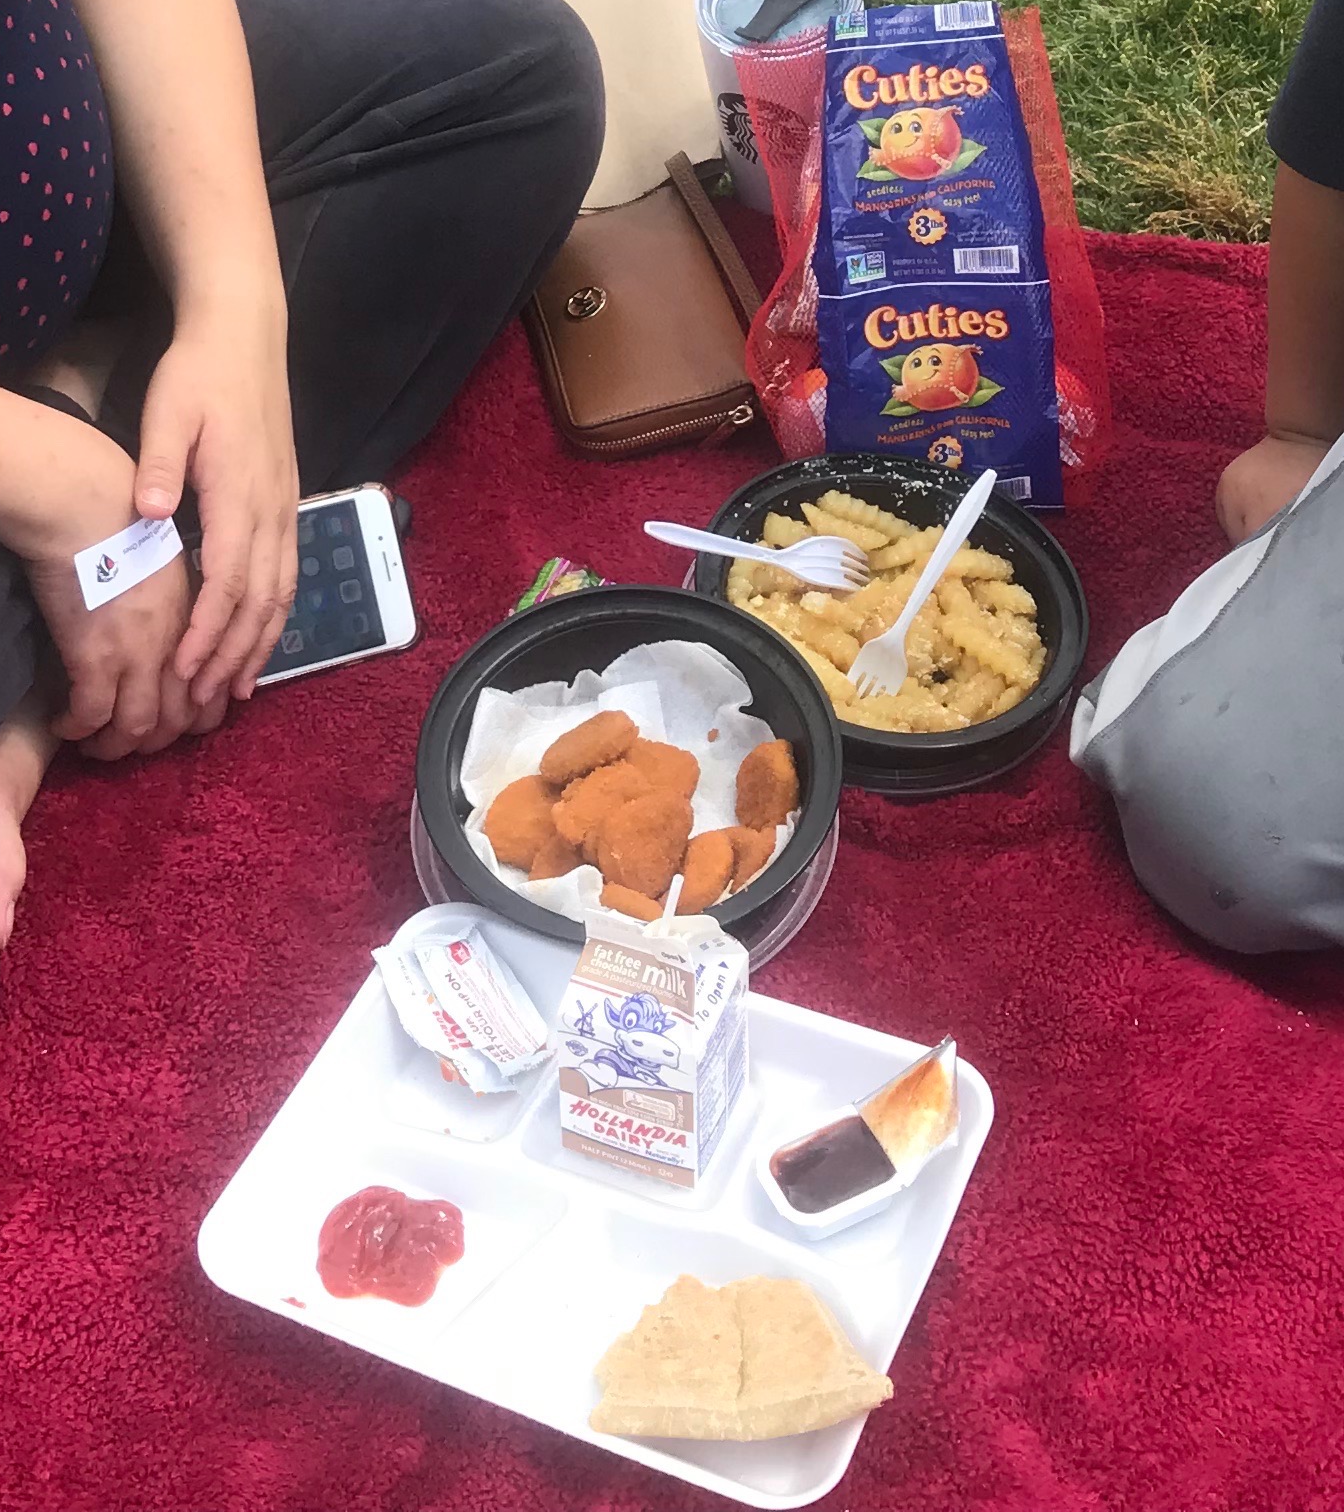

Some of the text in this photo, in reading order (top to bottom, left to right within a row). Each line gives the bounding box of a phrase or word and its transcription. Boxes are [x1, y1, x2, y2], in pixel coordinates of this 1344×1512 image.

[843, 63, 991, 110] Cuties
[855, 194, 917, 212] MANDARINS
[937, 179, 996, 194] CALIFORNIA
[866, 185, 904, 198] seedless
[864, 304, 1009, 348] Cuties
[590, 957, 638, 980] chocolate
[593, 944, 642, 970] fat free
[641, 962, 688, 999] milk
[707, 974, 726, 1006] Open
[472, 1009, 498, 1043] YOUR
[569, 1100, 687, 1148] HOLLANDIA
[593, 1122, 654, 1149] DAIRY
